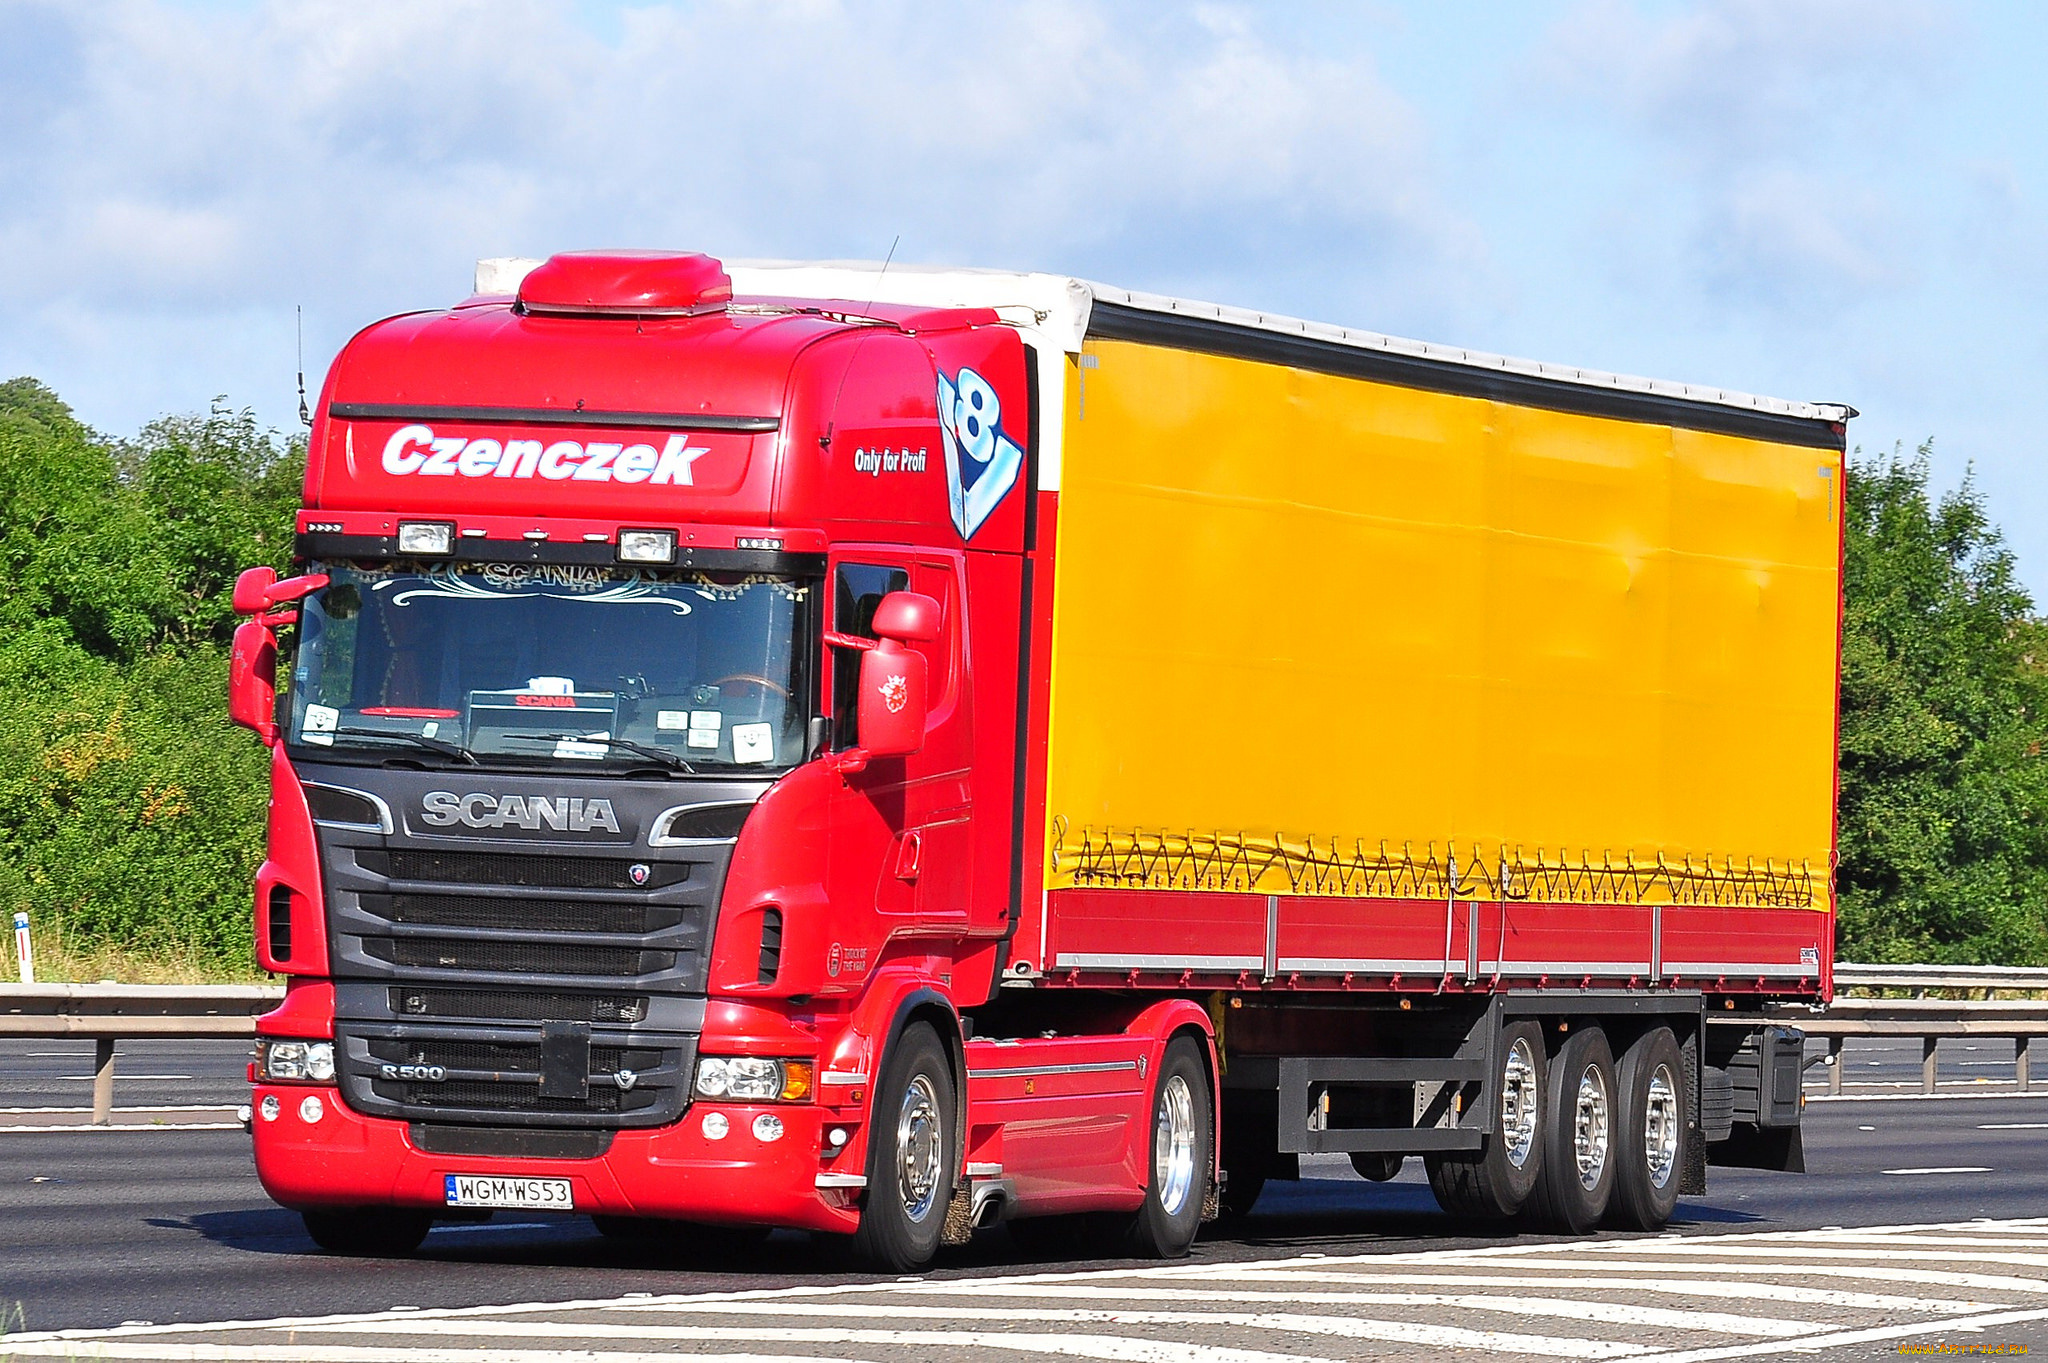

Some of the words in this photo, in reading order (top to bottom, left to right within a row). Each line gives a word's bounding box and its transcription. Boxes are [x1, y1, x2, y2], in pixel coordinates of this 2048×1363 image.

[382, 424, 711, 486] Czenczek
[854, 447, 882, 477] Only
[883, 447, 900, 472] for
[901, 447, 927, 472] Profi
[483, 562, 603, 588] SCANIA
[515, 695, 576, 707] SCANIA
[421, 791, 620, 833] SCANIA
